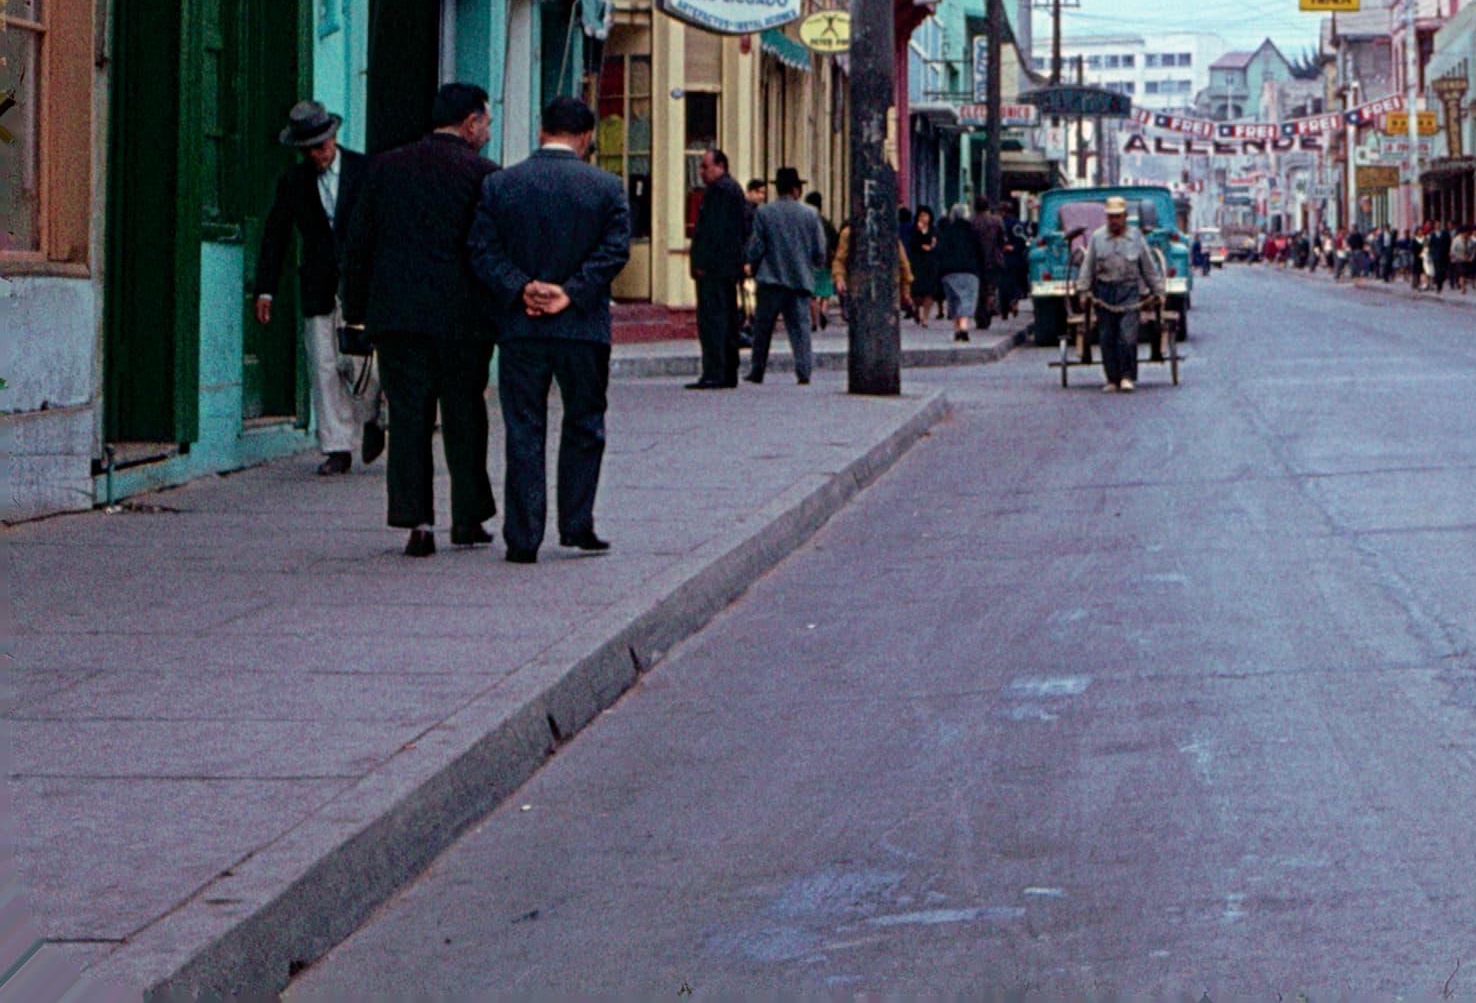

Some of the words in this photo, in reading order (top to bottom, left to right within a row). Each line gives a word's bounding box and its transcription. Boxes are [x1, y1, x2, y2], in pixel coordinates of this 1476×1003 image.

[1360, 97, 1401, 120] FREI
[1170, 117, 1212, 136] FREI
[1235, 124, 1276, 138] FREI
[1299, 115, 1339, 136] FREI
[1123, 133, 1324, 156] ALLENDE
